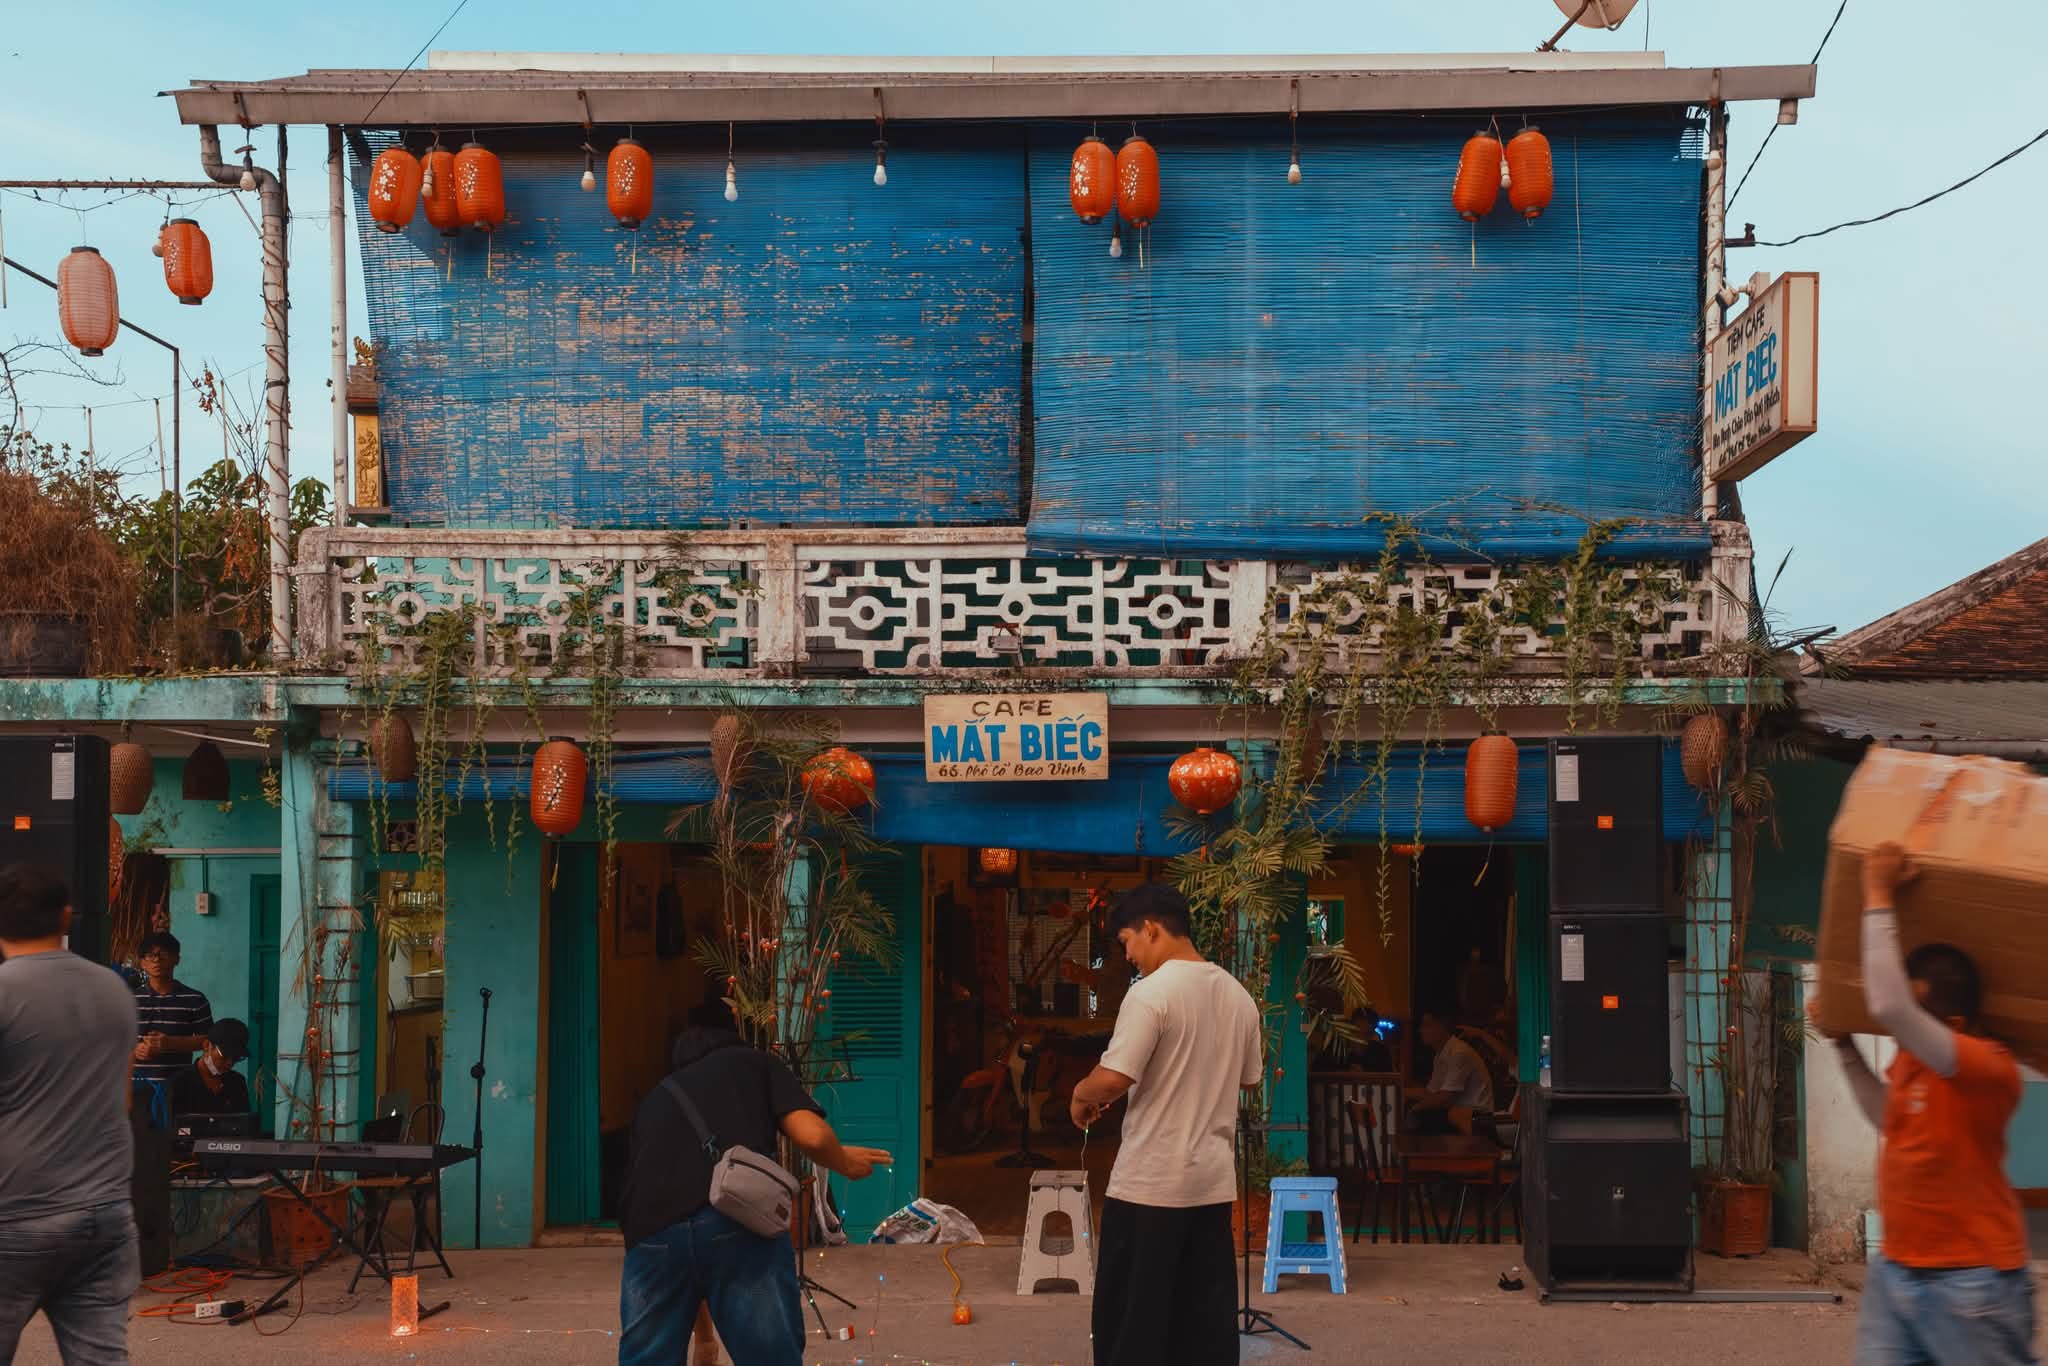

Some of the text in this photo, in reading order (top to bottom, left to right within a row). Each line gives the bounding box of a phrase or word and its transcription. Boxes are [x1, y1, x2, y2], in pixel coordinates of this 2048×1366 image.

[1745, 306, 1765, 338] CAFE
[1746, 326, 1777, 399] BIẾC
[972, 700, 1052, 716] CAFE
[931, 713, 1102, 763] MẮT BIẾC
[1013, 763, 1044, 776] Bao
[1047, 762, 1087, 777] Vinh
[207, 1142, 241, 1152] CASIO
